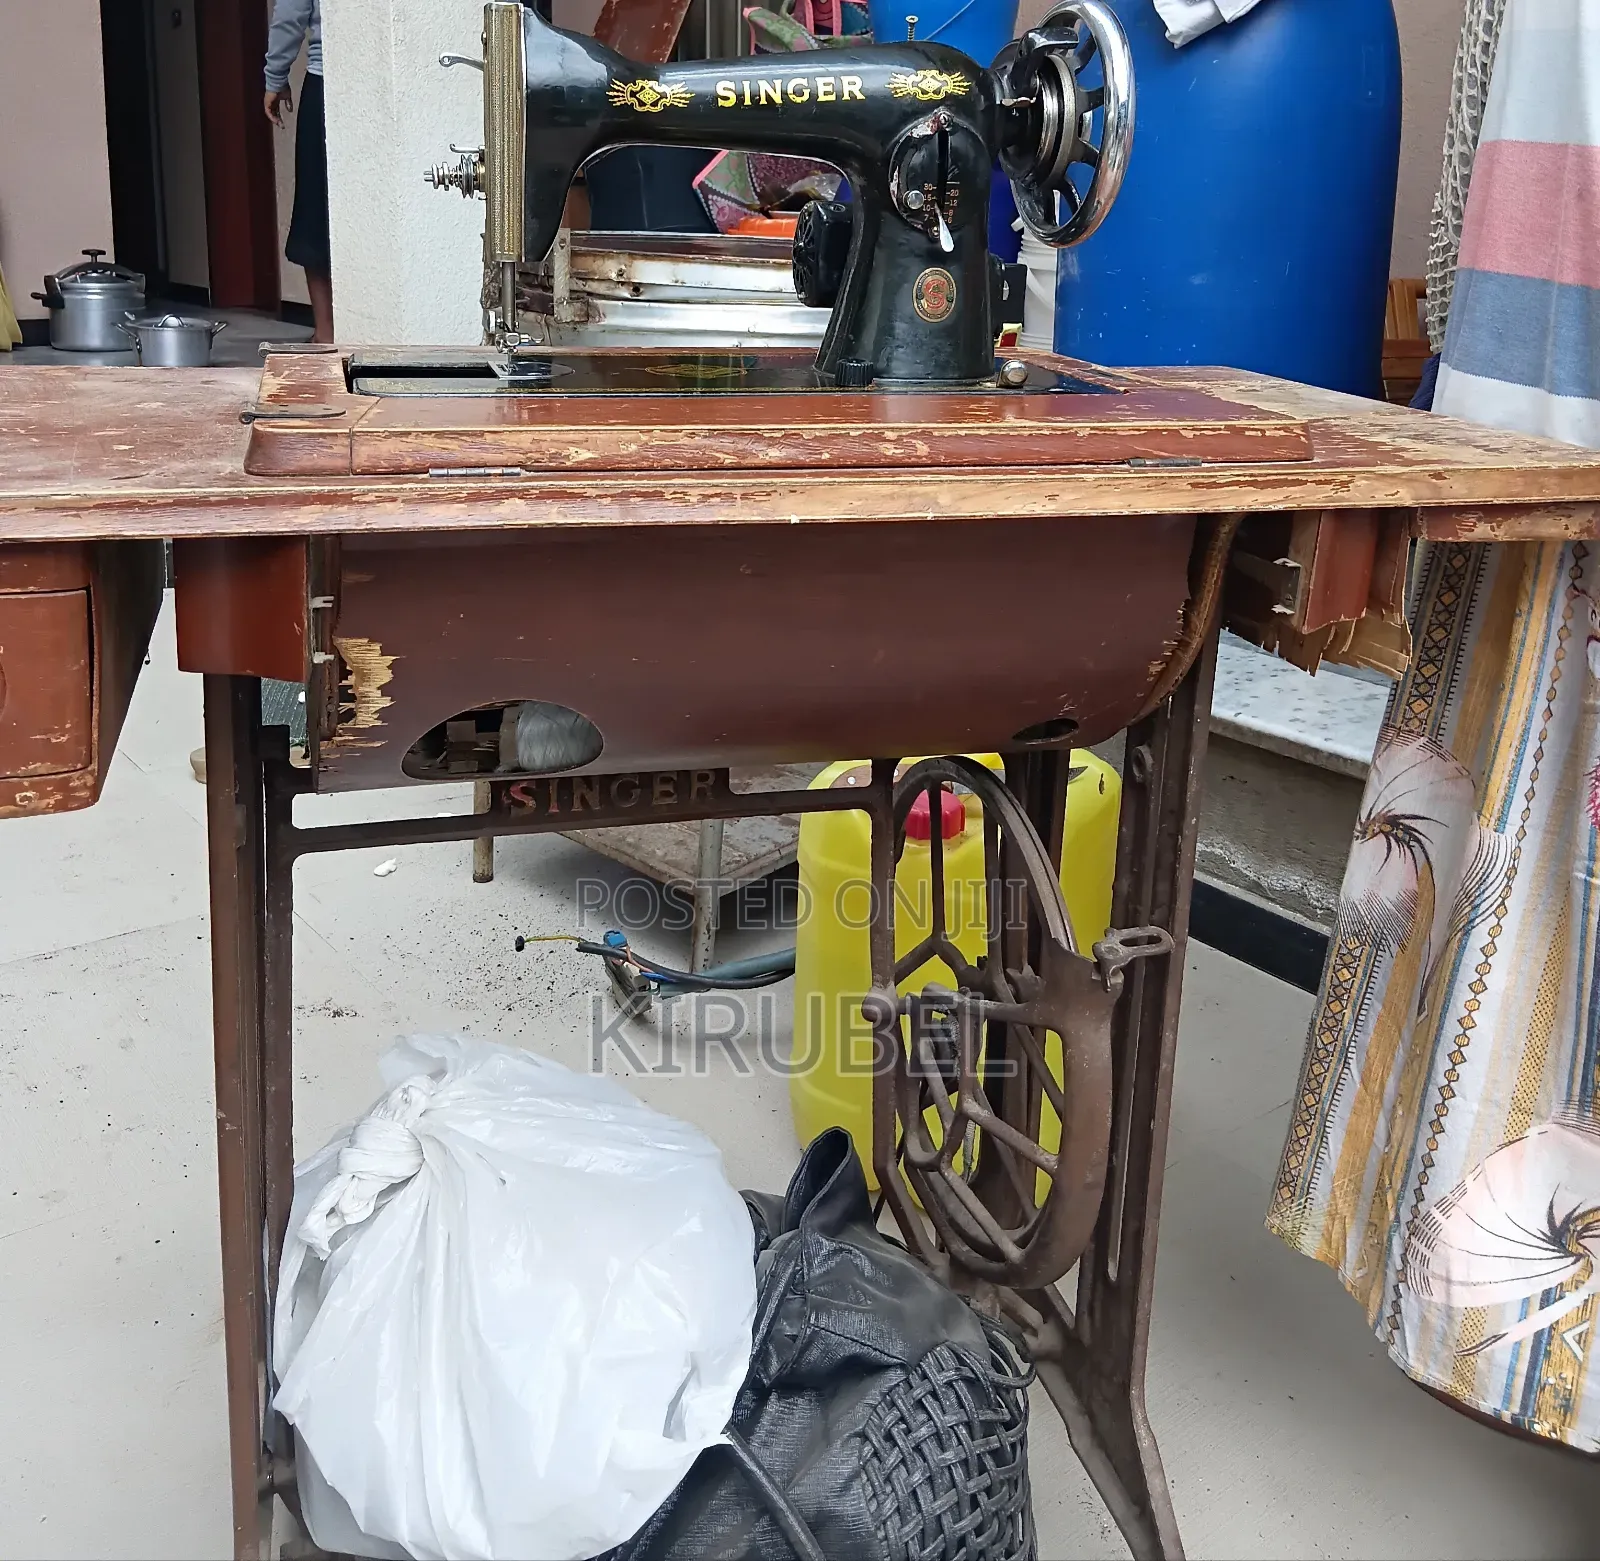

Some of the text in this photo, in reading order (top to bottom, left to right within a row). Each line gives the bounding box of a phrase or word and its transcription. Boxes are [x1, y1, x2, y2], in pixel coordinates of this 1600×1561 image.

[715, 75, 865, 107] SINGER
[924, 183, 933, 191] 30
[950, 189, 959, 197] 20
[922, 204, 931, 212] 10
[502, 769, 716, 817] SINGER
